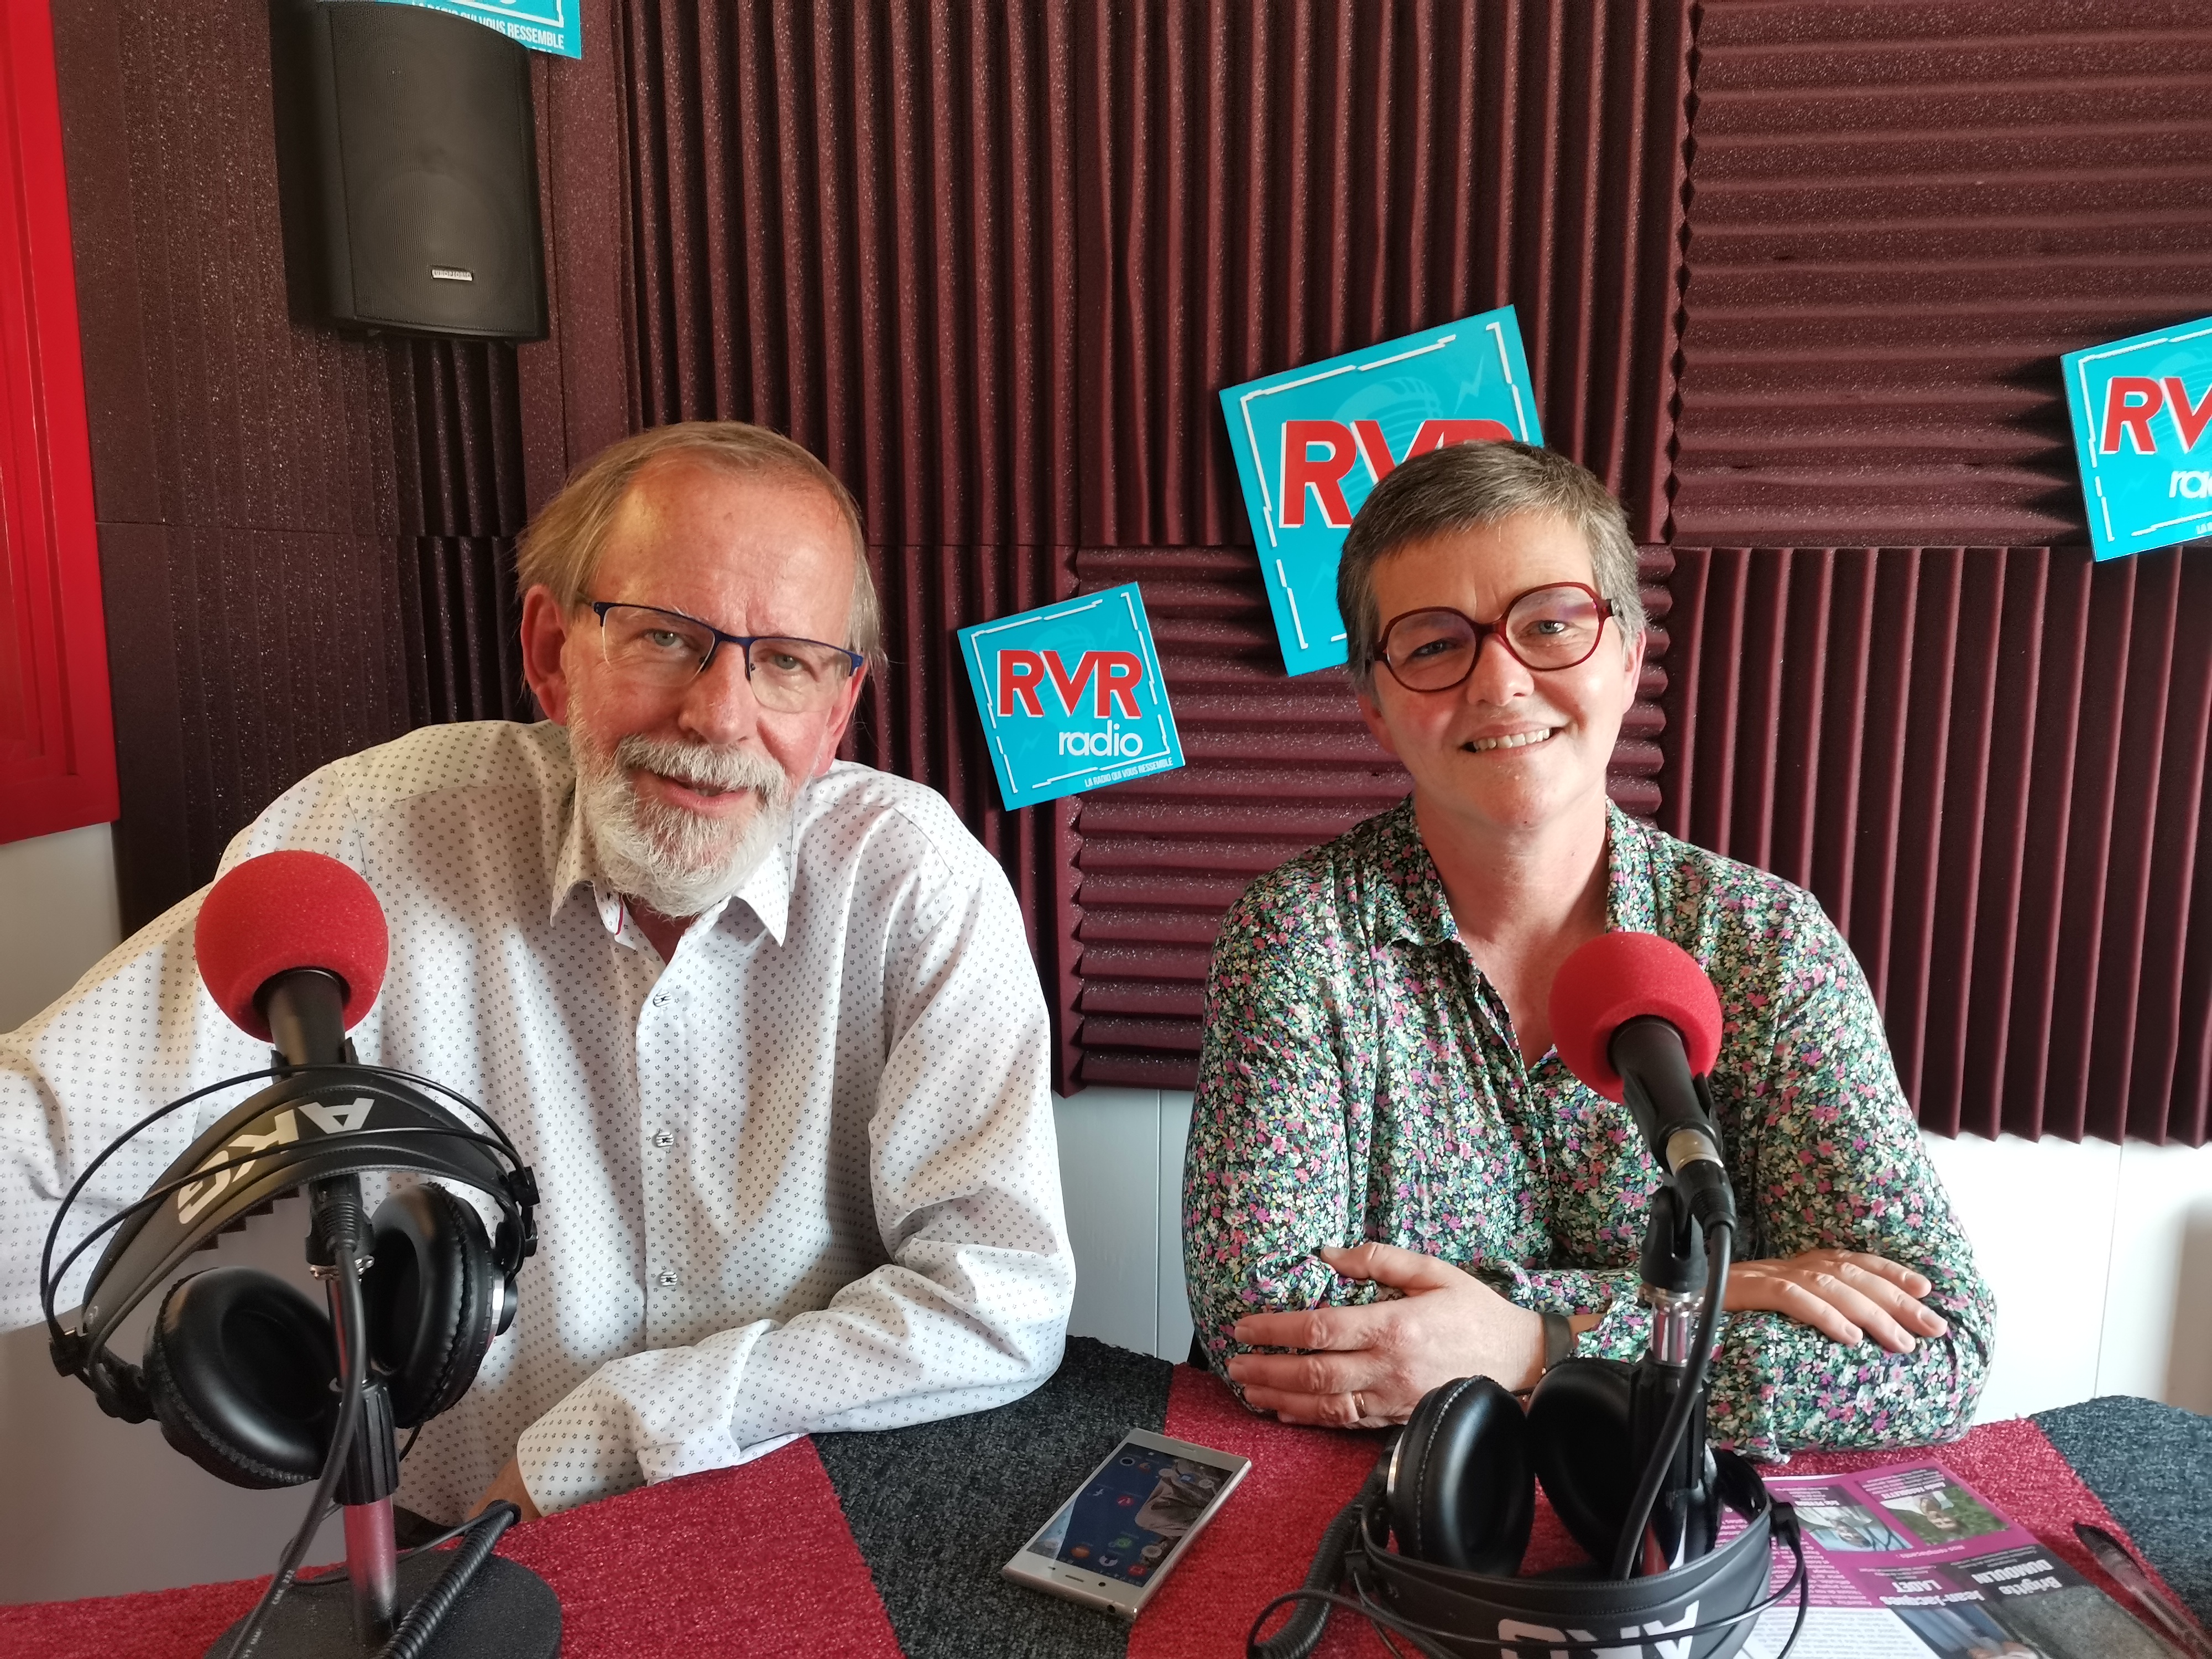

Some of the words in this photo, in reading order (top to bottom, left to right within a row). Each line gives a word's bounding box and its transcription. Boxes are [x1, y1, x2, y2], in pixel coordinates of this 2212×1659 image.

[507, 22, 565, 50] RESSEMBLE
[1279, 419, 1514, 529] RV
[997, 649, 1143, 719] RVR
[1059, 720, 1143, 757] radio
[1084, 778, 1093, 787] LA
[1093, 774, 1112, 785] RADIO
[1111, 770, 1123, 781] QUI
[1122, 766, 1139, 778] VOUS
[1138, 757, 1173, 774] RESSEMBLE
[177, 1097, 377, 1224] AKG
[1971, 1559, 2054, 1584] DUMOULIN
[1999, 1575, 2063, 1595] Brigitte
[1879, 1590, 1985, 1606] Jean-Jacques
[1892, 1580, 1943, 1593] LADET
